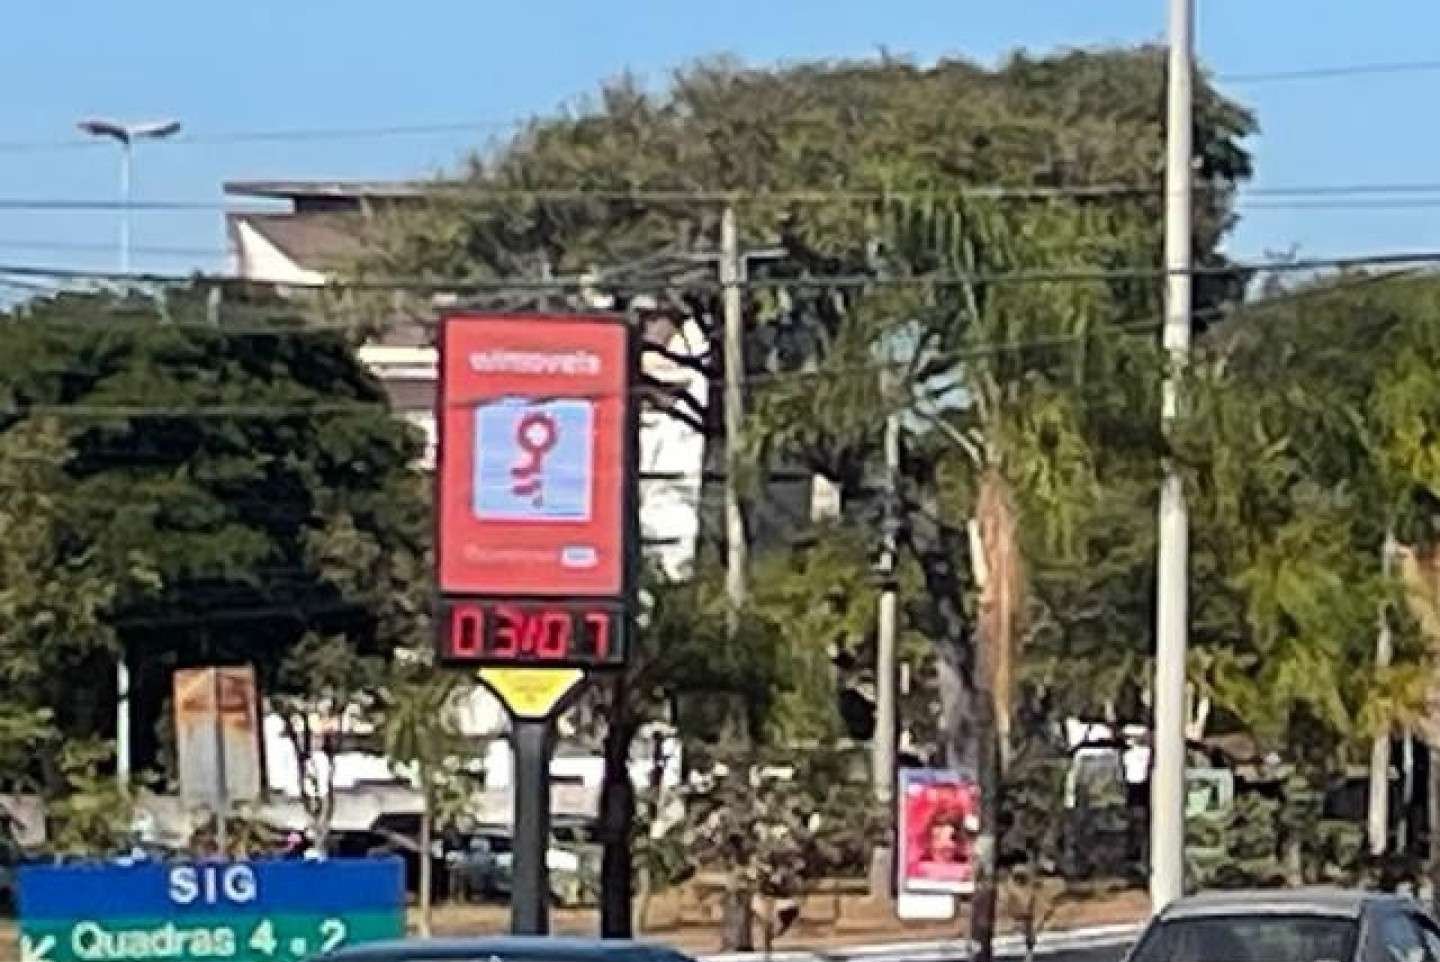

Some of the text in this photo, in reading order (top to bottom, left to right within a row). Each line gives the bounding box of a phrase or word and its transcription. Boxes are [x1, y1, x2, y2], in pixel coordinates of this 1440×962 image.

[169, 865, 258, 904] SIG
[71, 920, 237, 960] Quadras
[249, 918, 278, 955] 4
